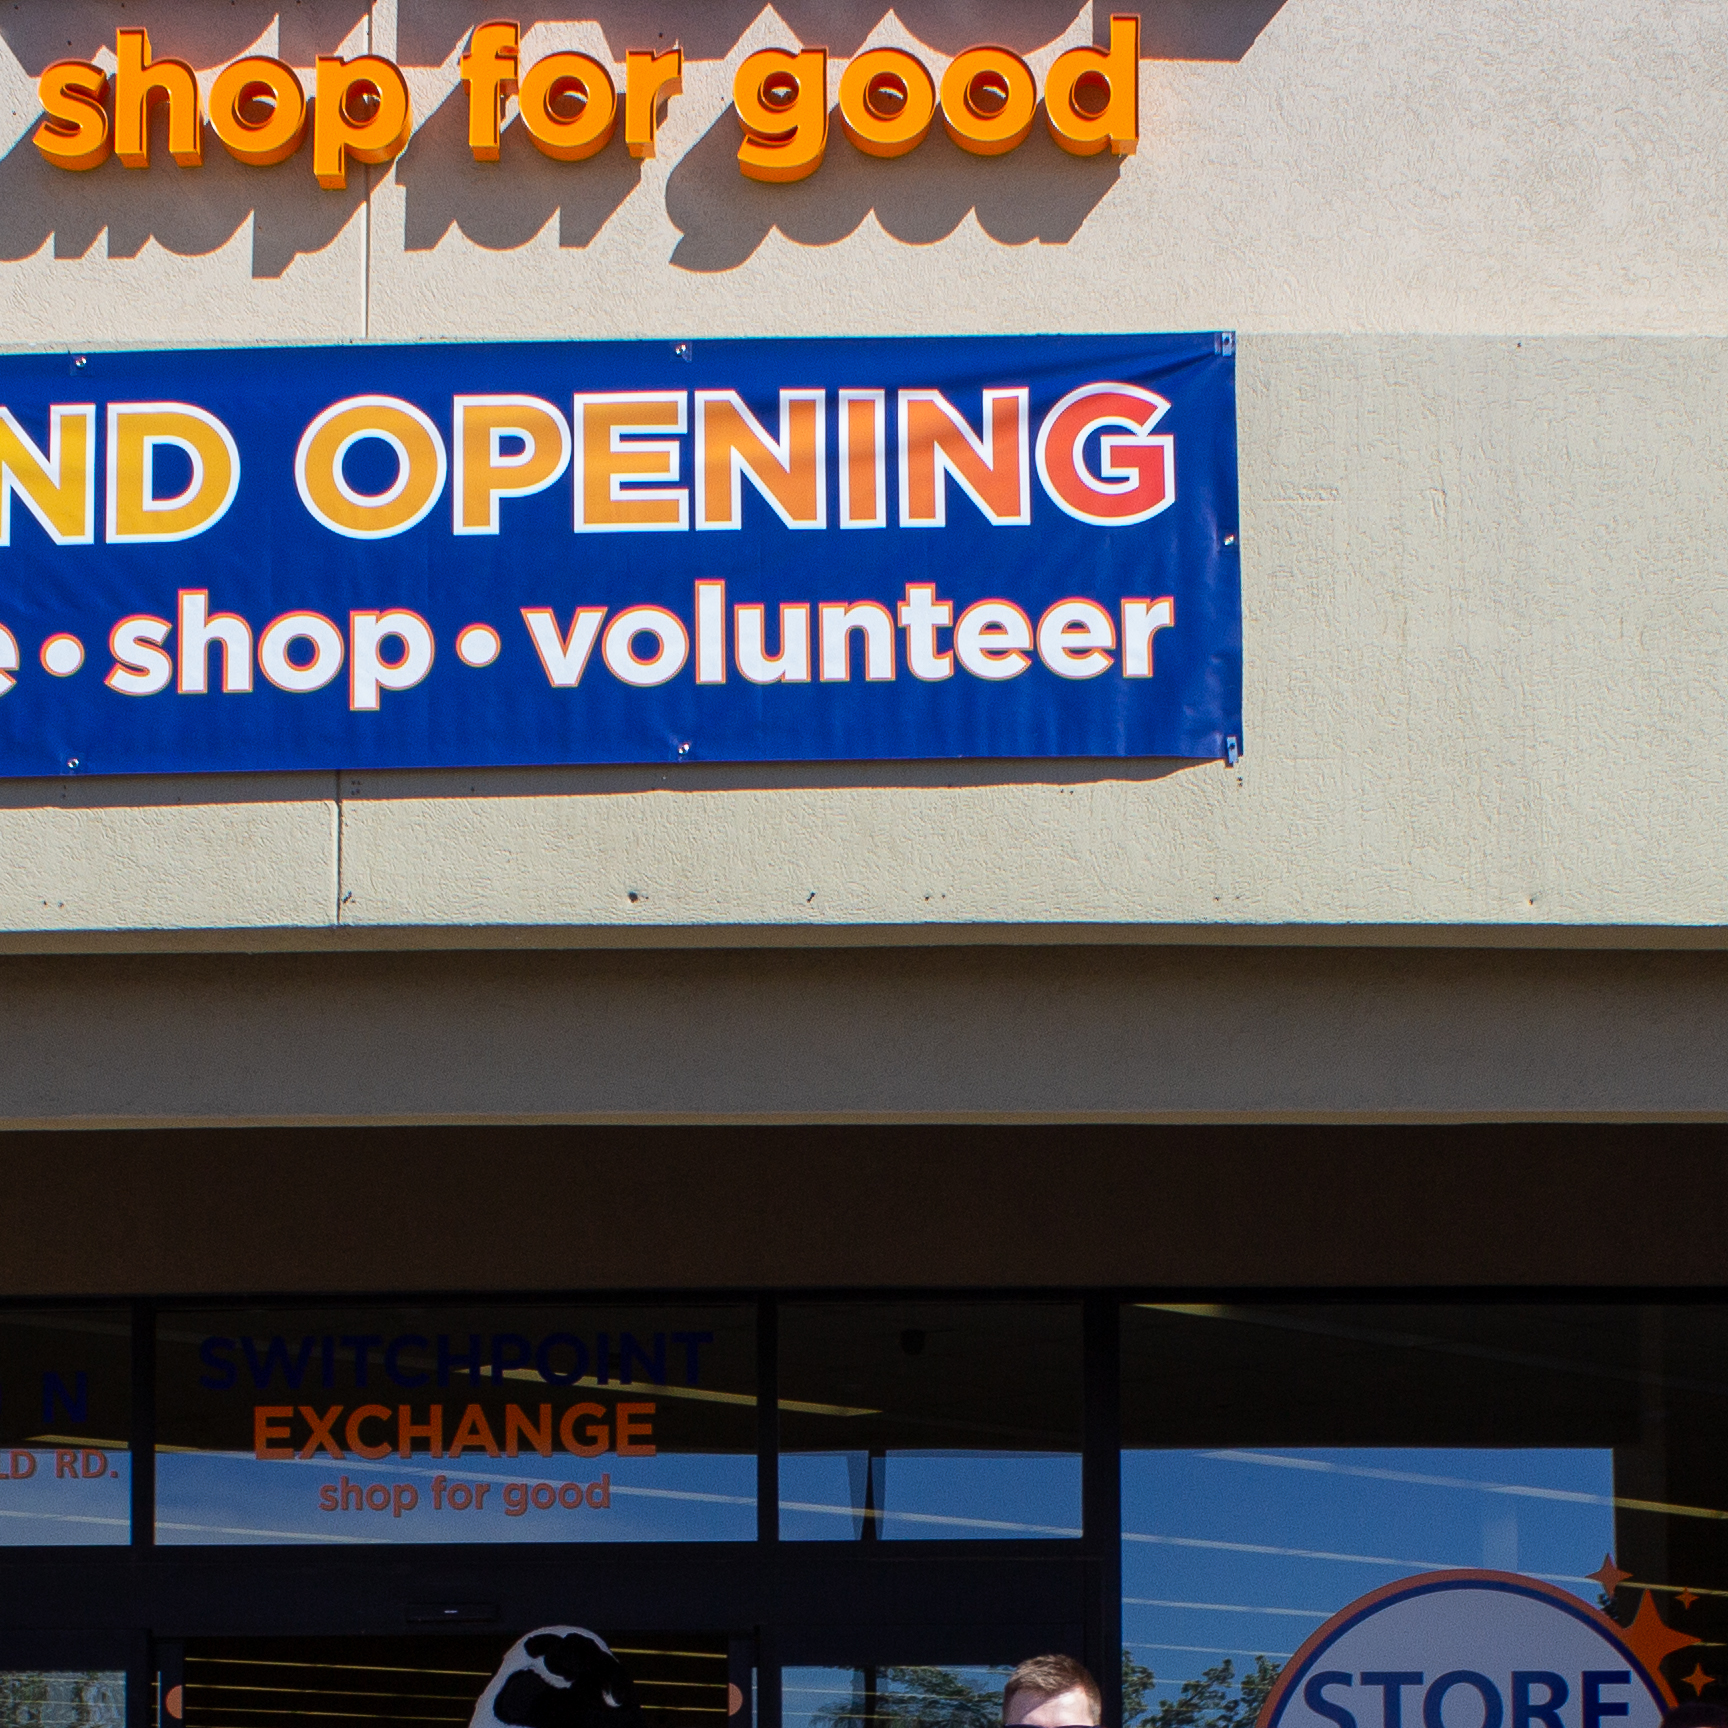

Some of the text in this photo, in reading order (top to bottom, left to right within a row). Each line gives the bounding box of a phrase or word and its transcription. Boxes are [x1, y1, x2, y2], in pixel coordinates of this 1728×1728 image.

[32, 13, 1143, 190] shop for good
[294, 380, 1177, 540] OPENING
[103, 588, 435, 711] shop
[521, 578, 1175, 688] volunteer
[198, 1331, 715, 1391] SWITCHPOINT
[41, 1370, 89, 1424] N
[253, 1401, 658, 1461] EXCHANGE
[54, 1448, 119, 1480] RD.
[318, 1473, 612, 1518] shop for good
